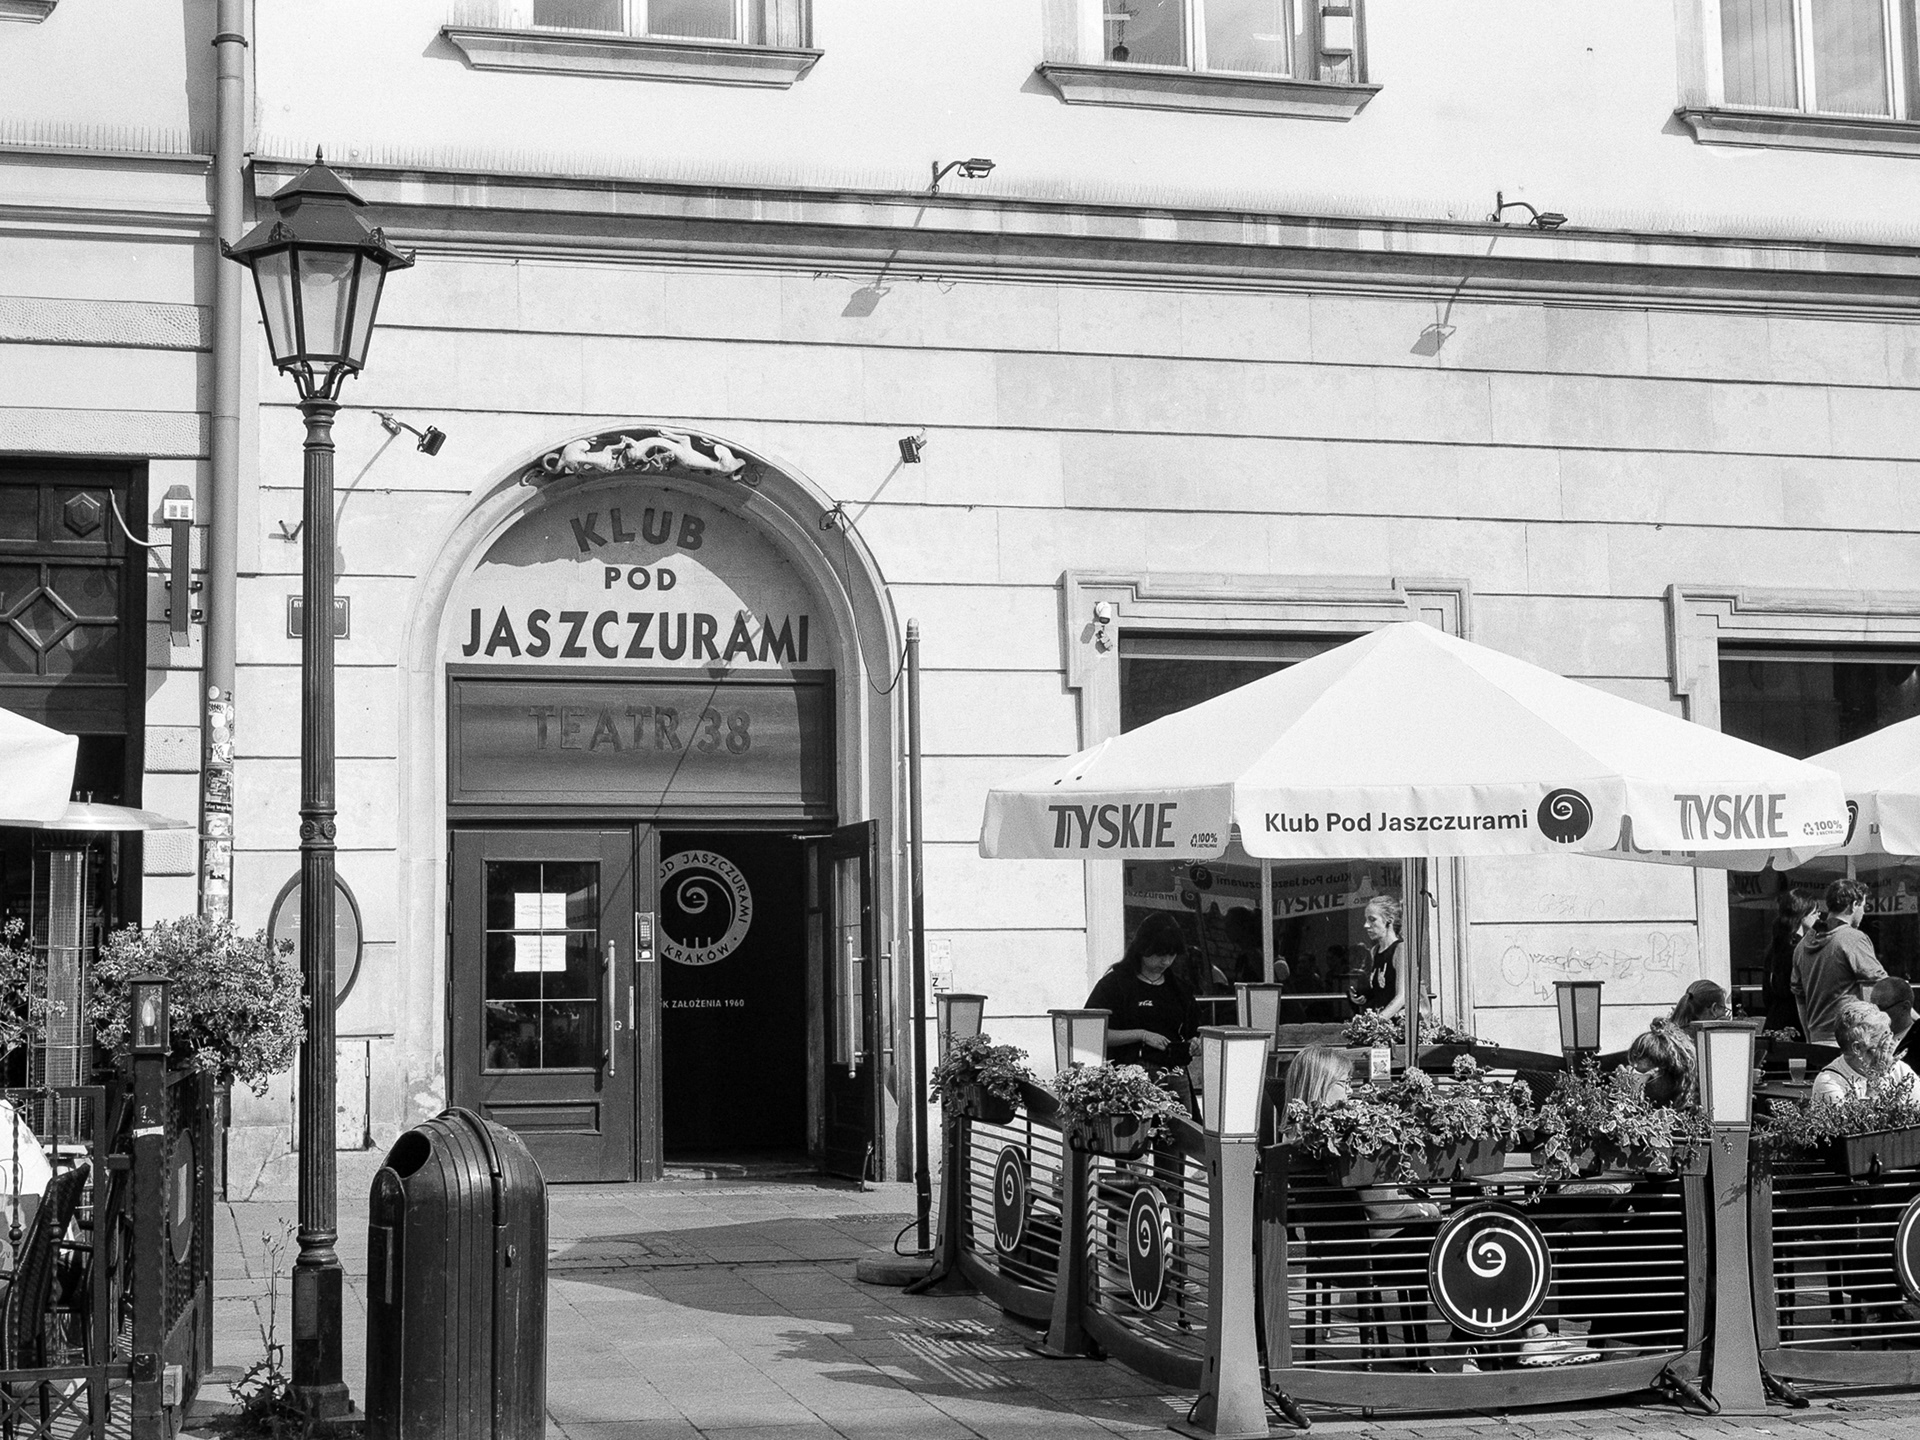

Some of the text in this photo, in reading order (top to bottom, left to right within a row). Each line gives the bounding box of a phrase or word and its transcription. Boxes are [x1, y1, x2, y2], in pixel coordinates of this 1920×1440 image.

[569, 508, 705, 552] KLUB
[605, 567, 676, 590] POD
[462, 605, 809, 664] JASZCZURAMI
[529, 704, 751, 755] TEATR 38
[1048, 803, 1177, 849] TYSKIE
[1265, 809, 1528, 832] Klub Pod Jaszczurami
[1673, 793, 1788, 840] TYSKIE
[1814, 820, 1843, 831] 100%
[1198, 833, 1217, 843] 100%
[660, 853, 750, 923] OD JASZCZURAMI
[664, 943, 729, 963] KRAKÓW
[671, 997, 722, 1008] ZAŁOŻENIA
[724, 999, 745, 1008] 1960
